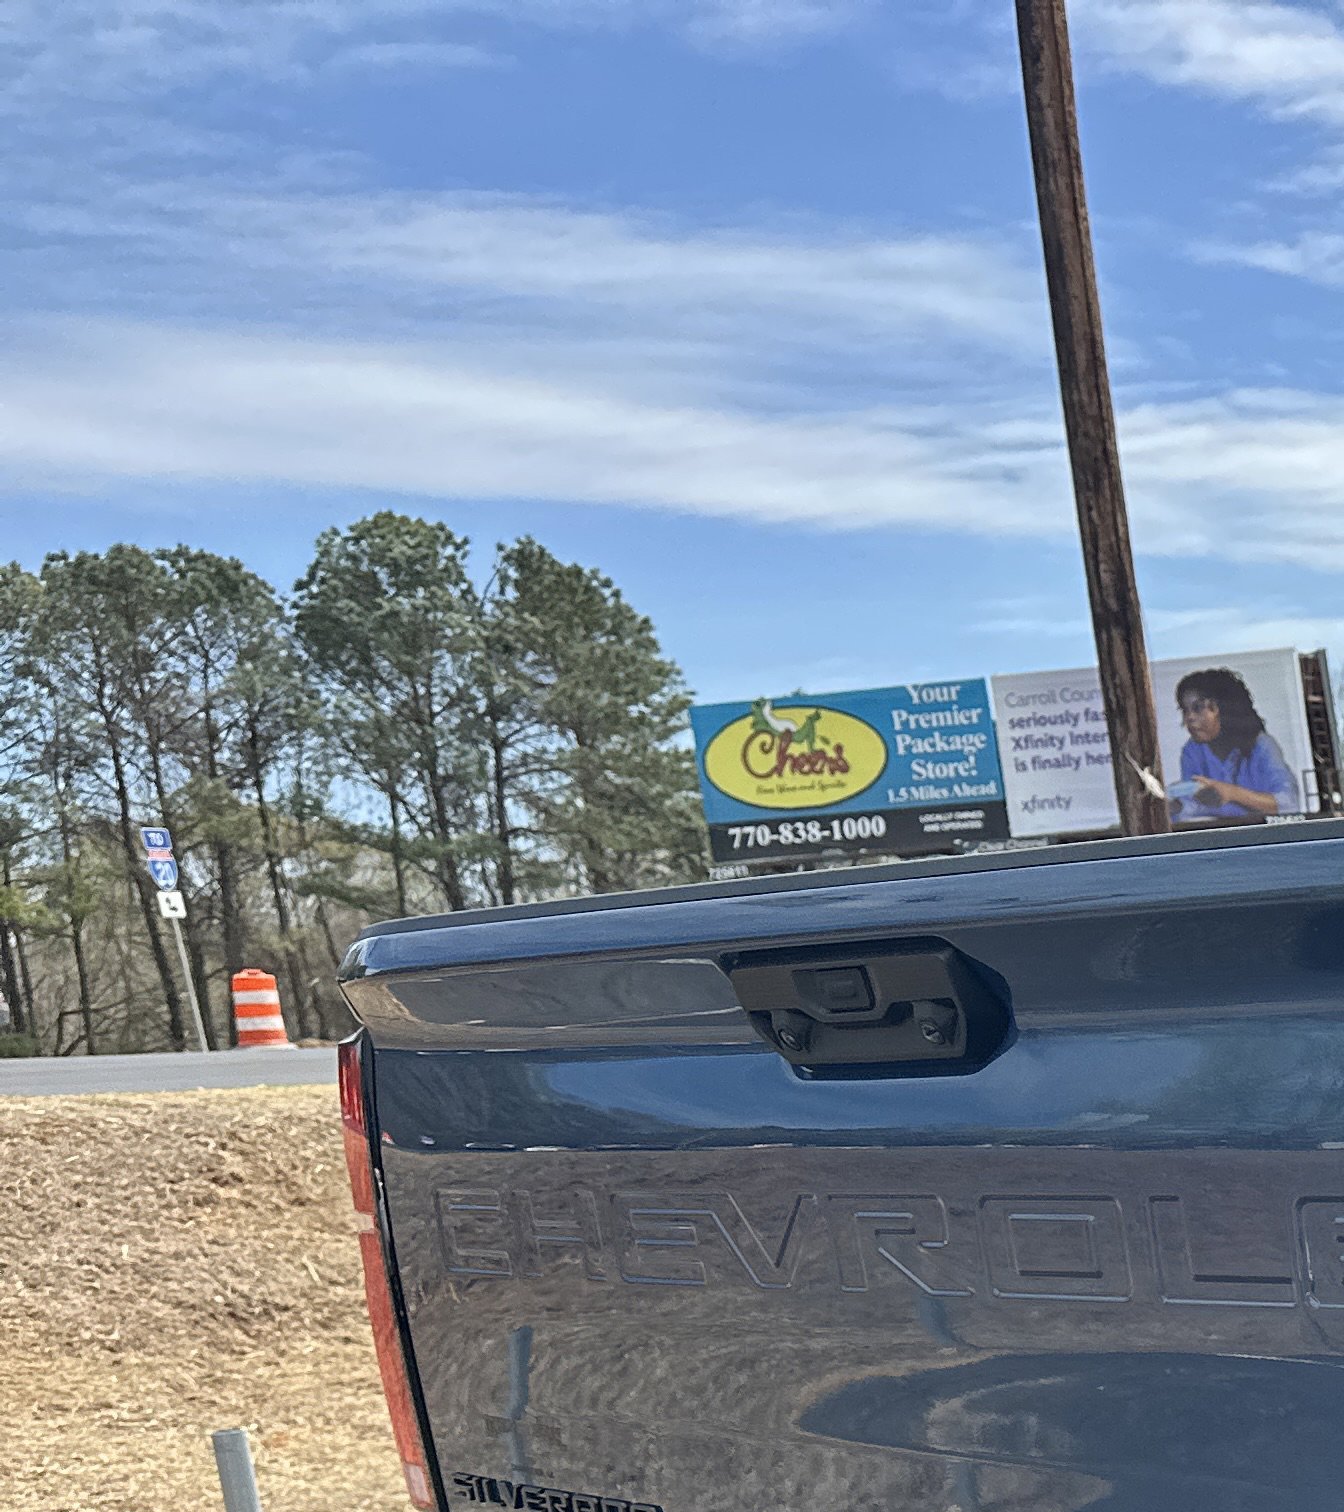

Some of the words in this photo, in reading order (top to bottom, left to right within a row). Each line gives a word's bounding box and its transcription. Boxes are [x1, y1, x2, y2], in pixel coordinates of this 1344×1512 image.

[905, 684, 961, 704] Your
[1005, 689, 1057, 708] Carroll
[1060, 687, 1100, 704] Coun
[891, 704, 983, 731] Premier
[1009, 710, 1080, 729] seriously
[895, 731, 987, 756] Package
[1011, 734, 1066, 751] Xfinity
[1069, 731, 1109, 746] Inter
[741, 728, 850, 779] Cheers
[1014, 757, 1027, 772] is
[1031, 753, 1081, 771] finally
[1085, 751, 1111, 767] her
[911, 755, 979, 781] Store!
[887, 787, 909, 803] 1.5
[910, 785, 949, 800] Miles
[952, 780, 997, 797] Ahead
[1021, 794, 1073, 814] xfinity
[728, 815, 887, 849] 770-838-1000
[155, 862, 175, 887] 20
